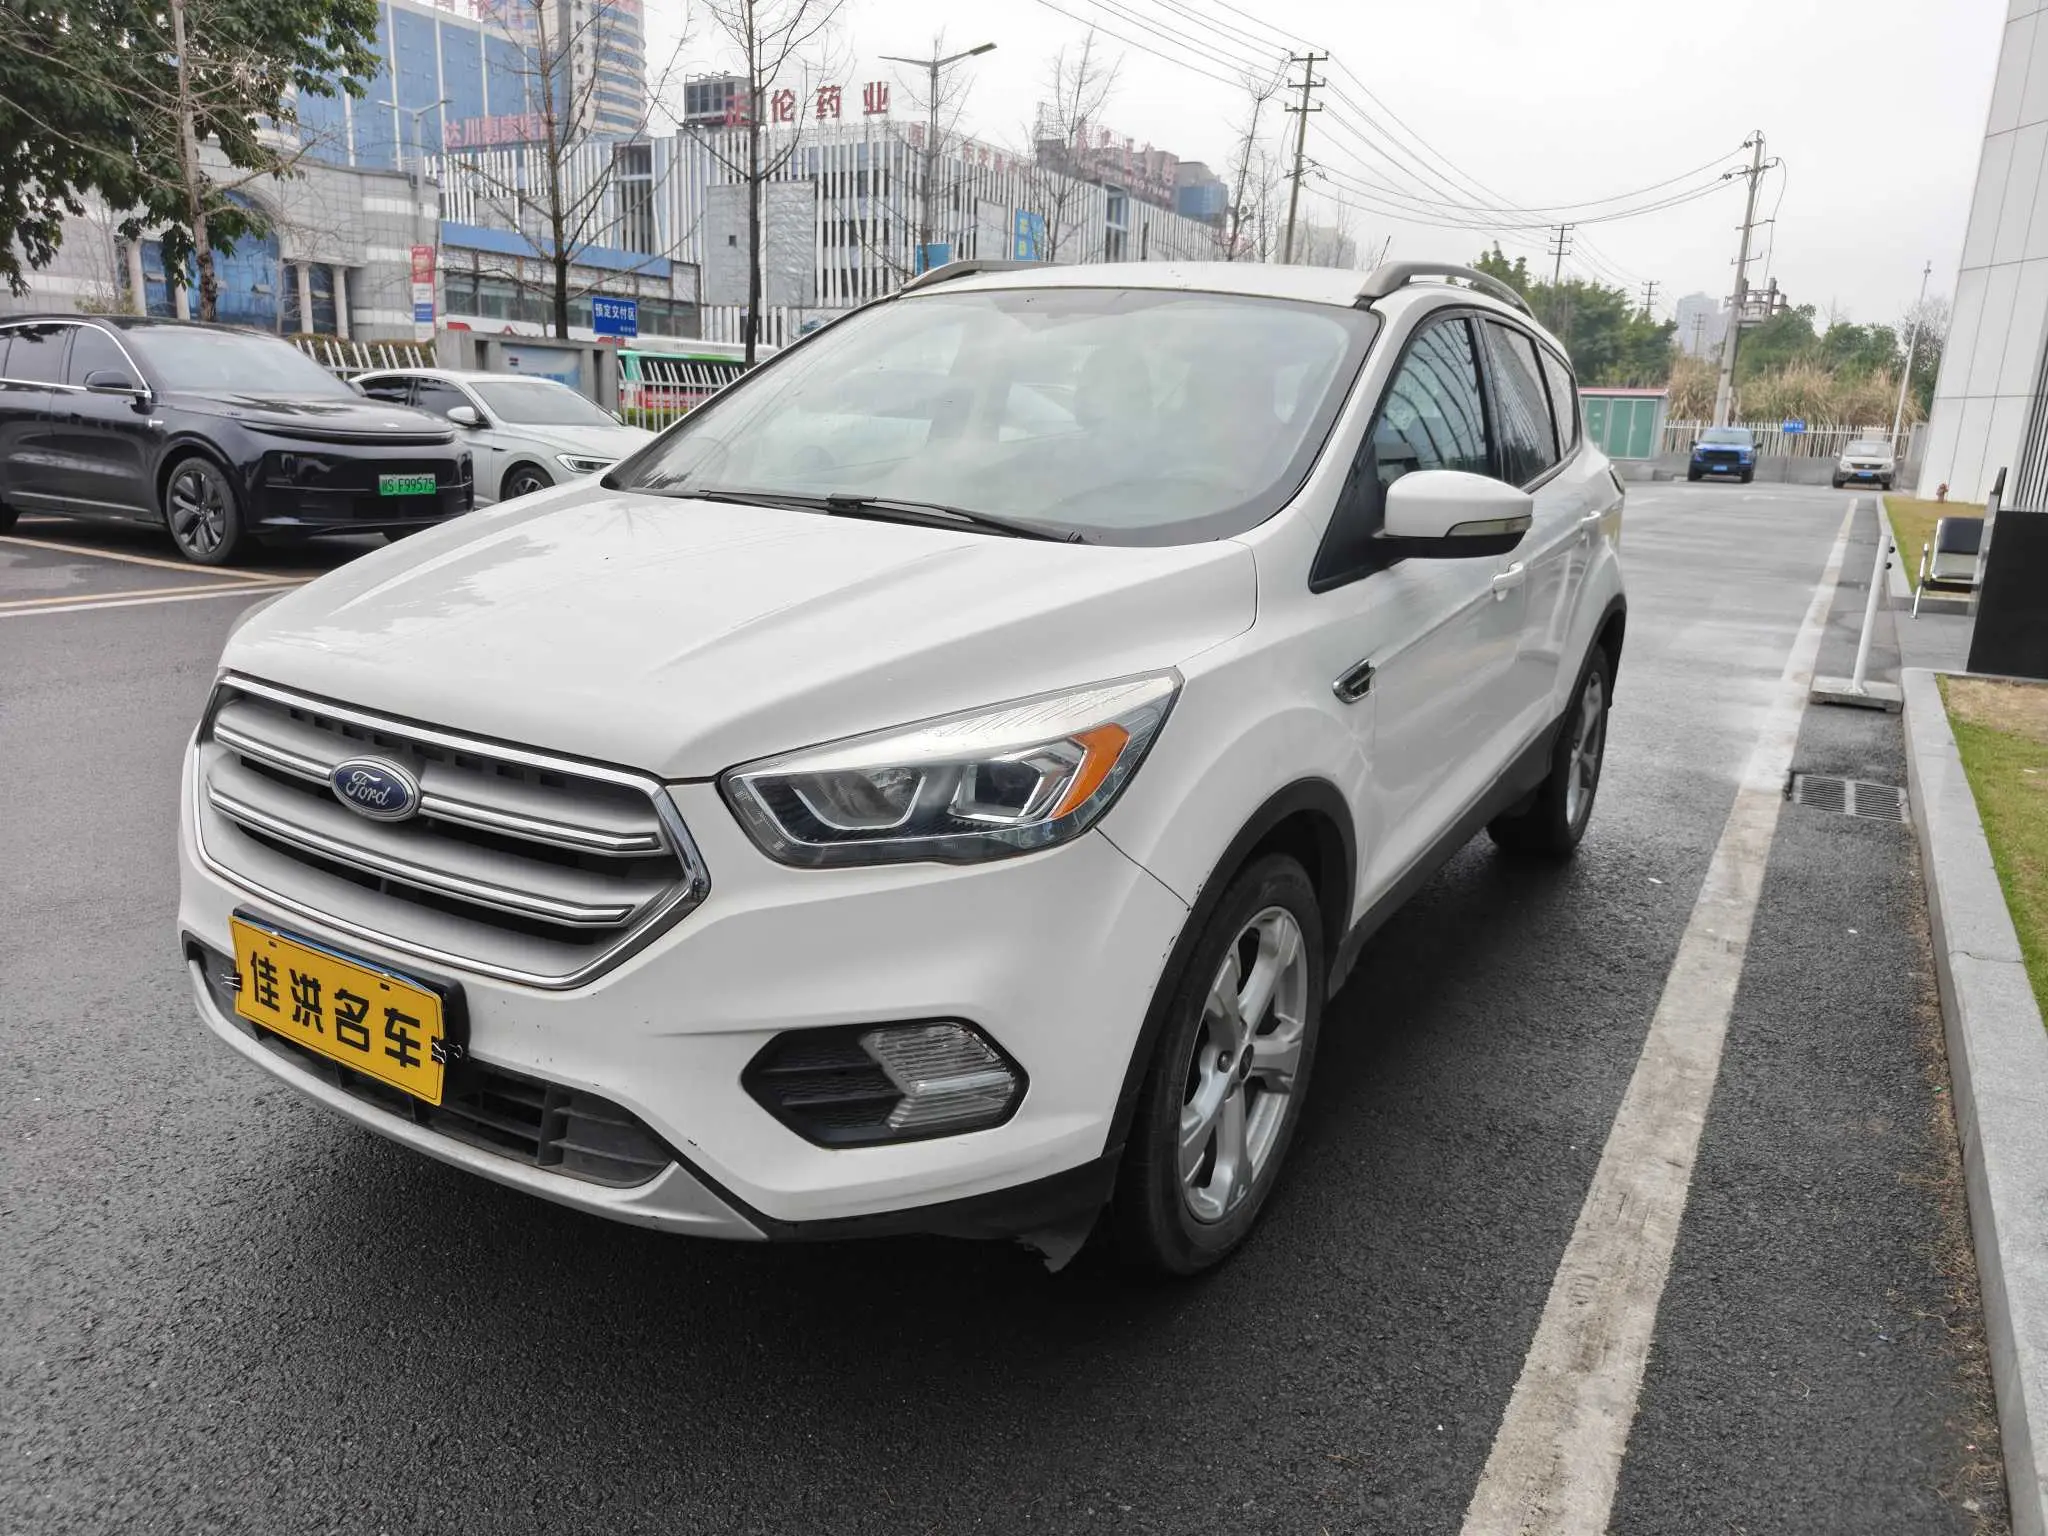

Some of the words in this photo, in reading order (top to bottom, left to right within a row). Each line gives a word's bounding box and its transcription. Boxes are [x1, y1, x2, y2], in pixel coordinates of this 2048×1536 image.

[346, 770, 391, 806] Ford
[251, 951, 421, 1068] 佳洪名车
